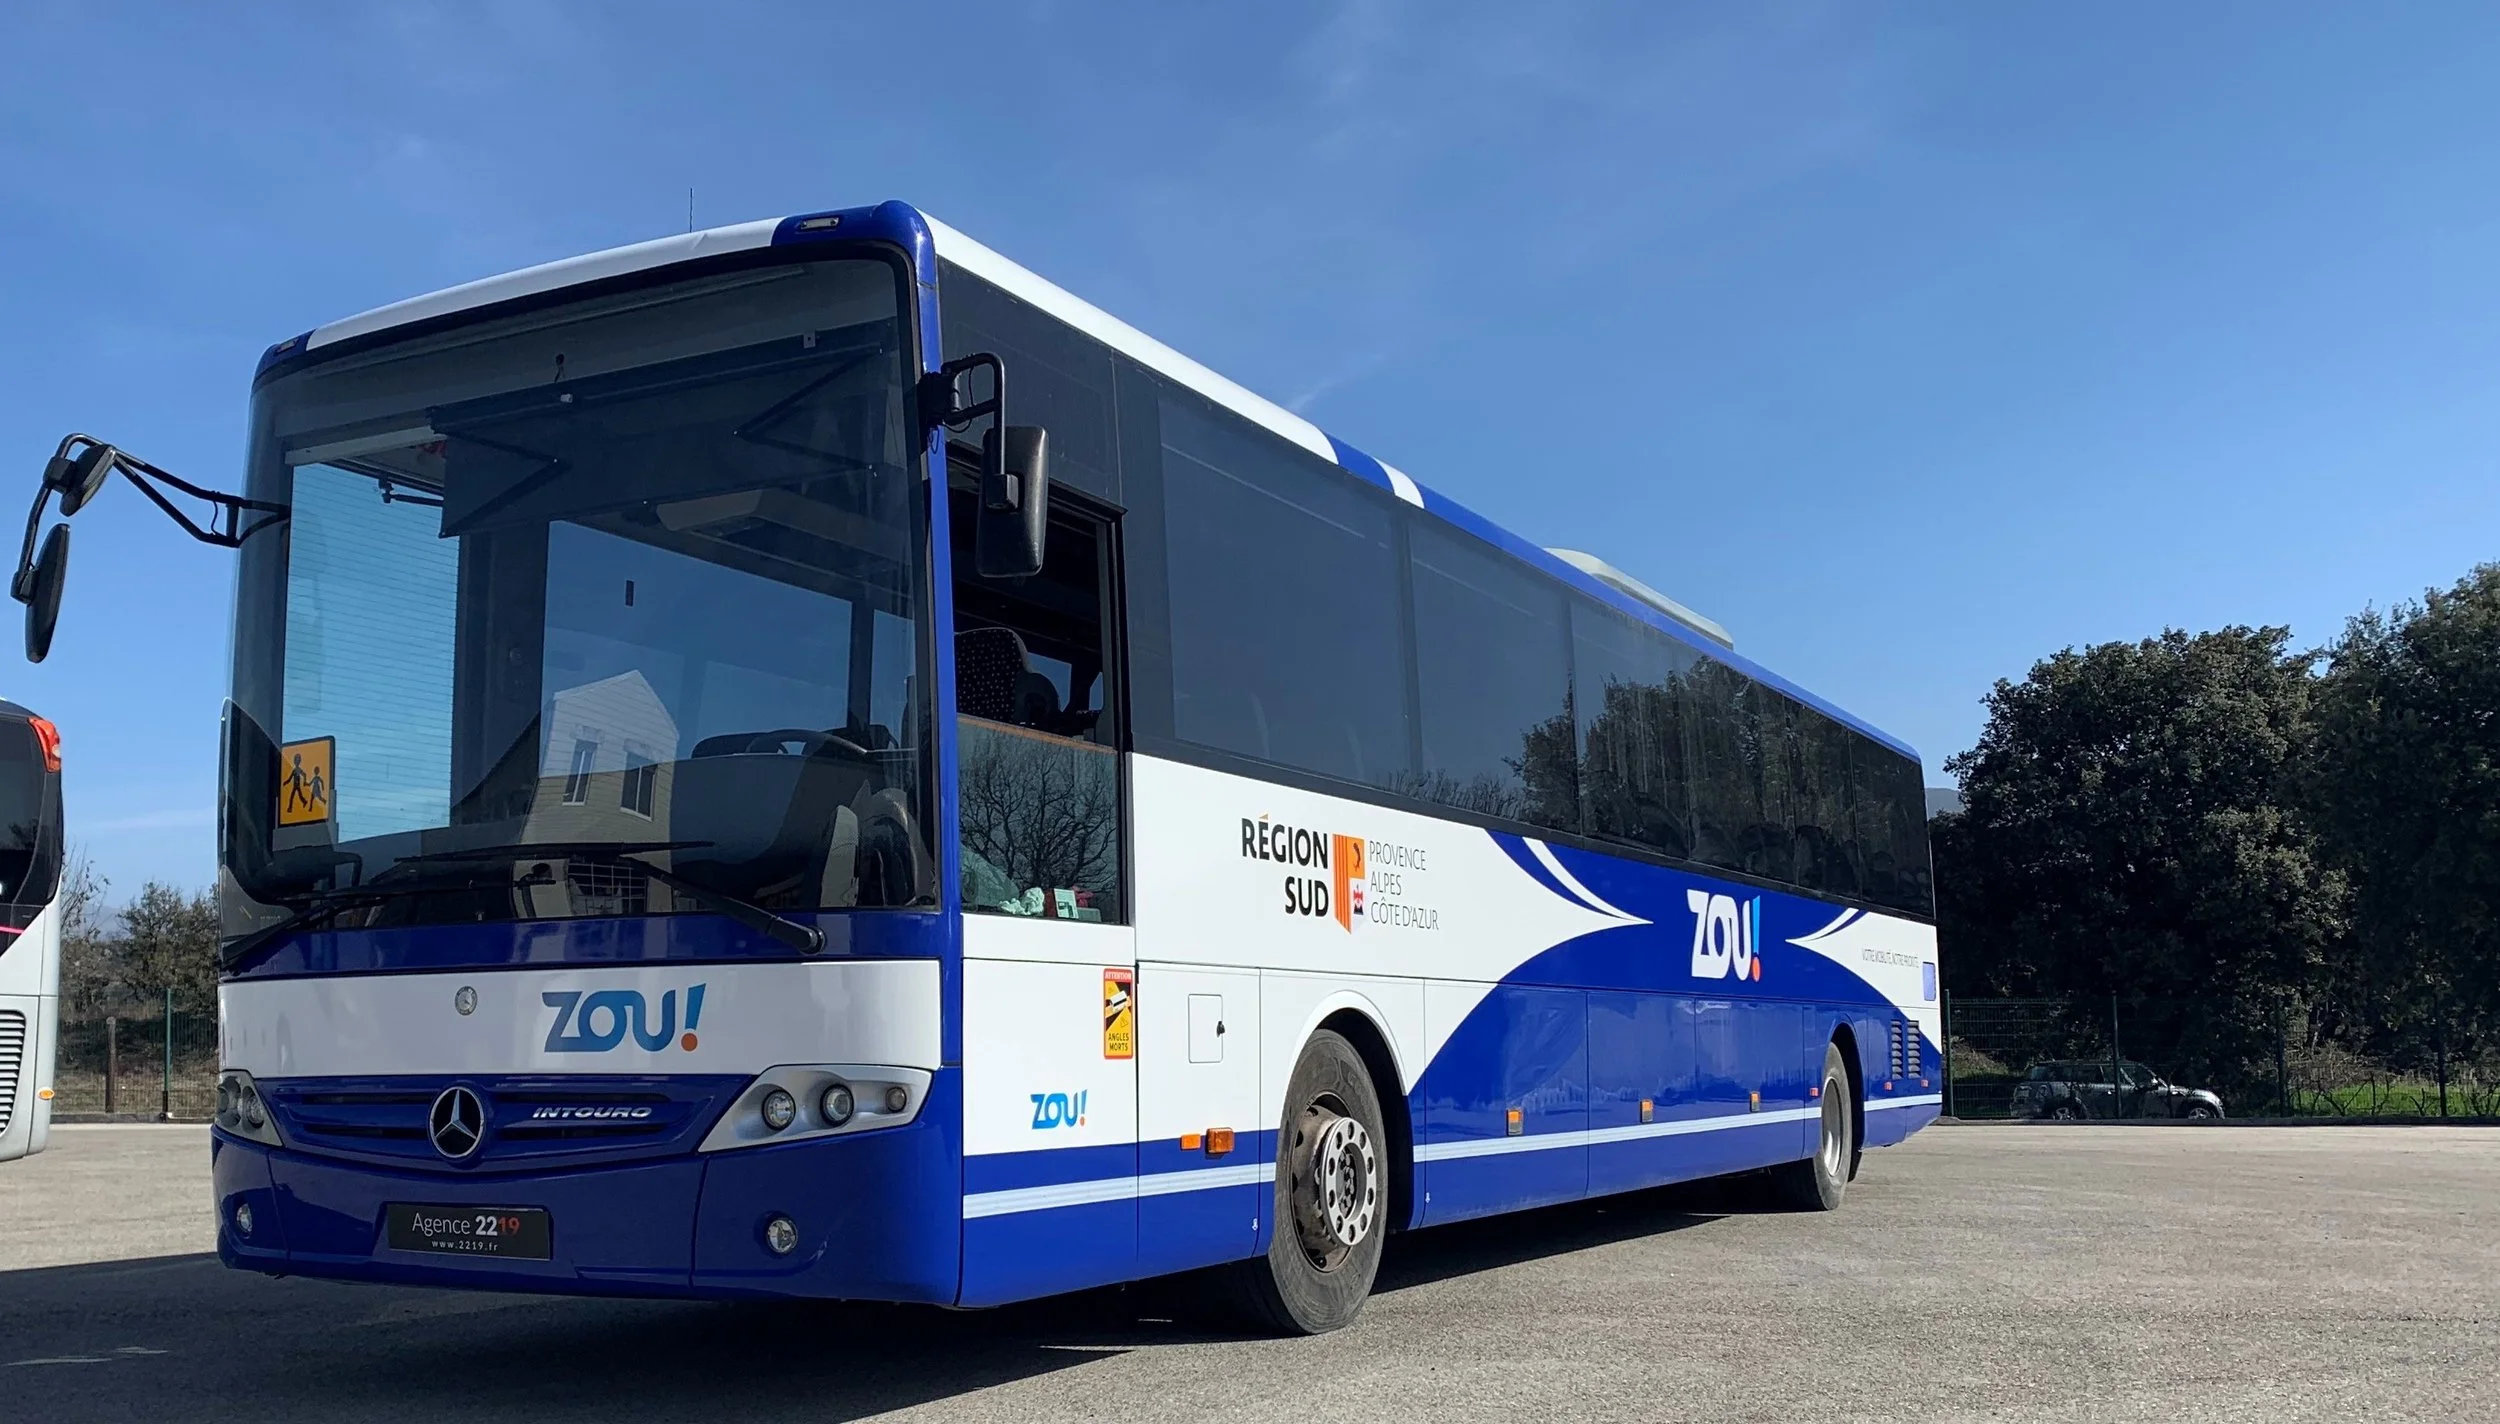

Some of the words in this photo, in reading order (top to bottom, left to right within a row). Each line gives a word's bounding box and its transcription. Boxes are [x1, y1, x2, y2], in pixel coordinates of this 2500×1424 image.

[1241, 813, 1328, 869] RÉGION
[1369, 840, 1426, 871] PROVENCE
[1284, 875, 1329, 917] SUD
[1370, 871, 1402, 896] ALPES
[1371, 896, 1400, 926] CÔTE
[1402, 902, 1439, 930] D'AZUR
[1687, 888, 1760, 983] ZOU!
[541, 983, 706, 1052] ZOU!
[1108, 1033, 1129, 1041] ANGLES
[1109, 1042, 1128, 1051] MORTS
[532, 1107, 652, 1119] INTOURO
[1030, 1089, 1087, 1130] ZOU!
[412, 1213, 471, 1237] Agence
[475, 1215, 520, 1236] 2219
[431, 1240, 498, 1251] www.2219.fr
